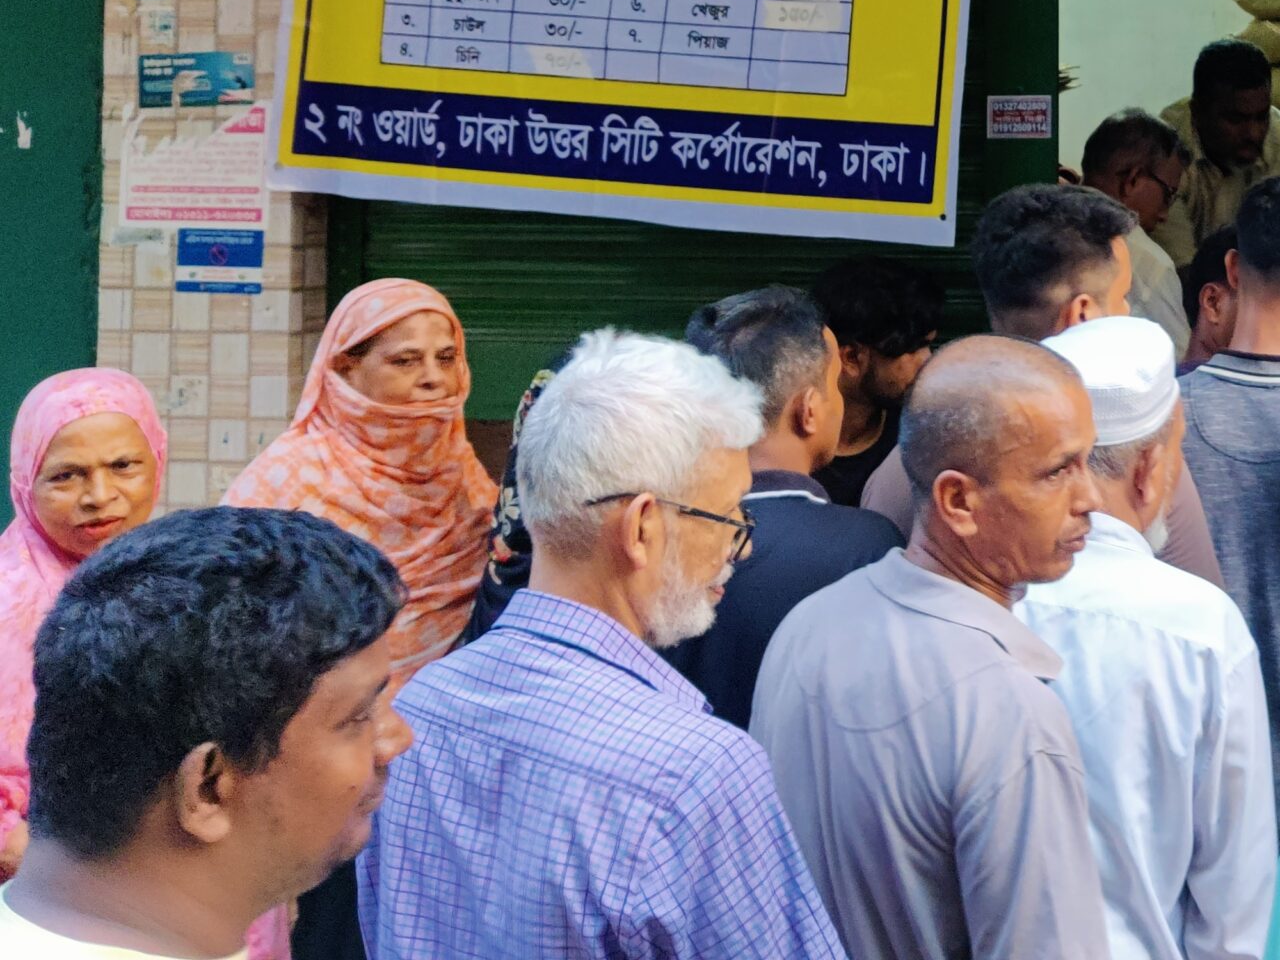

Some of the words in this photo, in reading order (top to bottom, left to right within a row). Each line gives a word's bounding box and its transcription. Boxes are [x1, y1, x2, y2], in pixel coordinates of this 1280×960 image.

[691, 3, 730, 21] খেজুর
[544, 20, 583, 41] ৩০/-
[455, 45, 481, 64] চিনি
[304, 103, 327, 143] ২
[336, 105, 364, 146] নং
[372, 99, 446, 159] ওয়ার্ড,
[456, 113, 520, 157] ঢাকা
[524, 108, 594, 162] উত্তর
[600, 113, 664, 166] সিটি
[669, 120, 828, 188] কর্পোরেশন,
